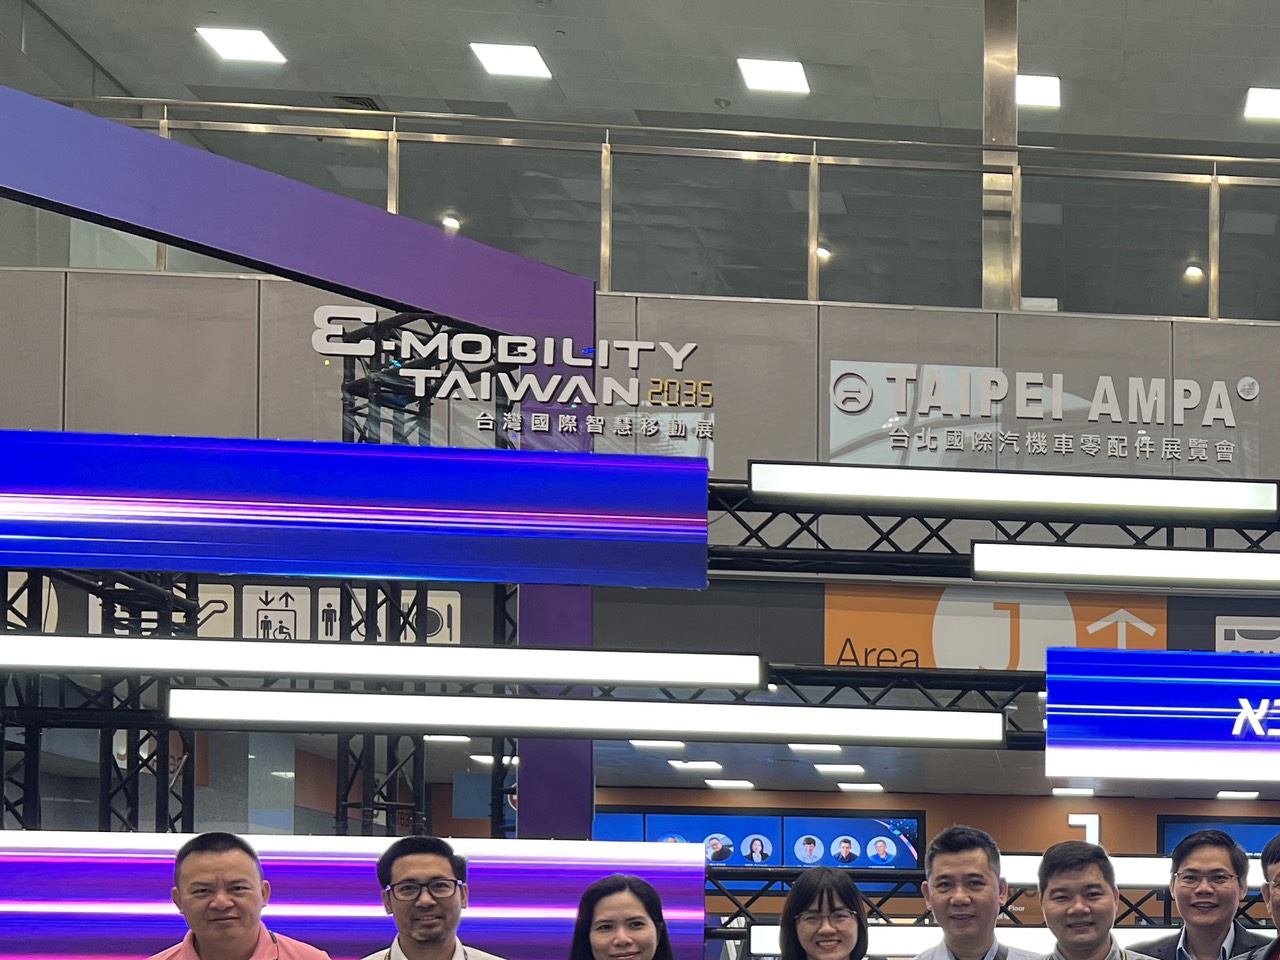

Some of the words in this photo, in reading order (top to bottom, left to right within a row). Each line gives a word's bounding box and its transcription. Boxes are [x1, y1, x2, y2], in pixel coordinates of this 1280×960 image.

[398, 368, 640, 406] TAIWAN
[647, 377, 714, 407] 2035
[886, 367, 1064, 420] TAIPEI
[1087, 375, 1237, 428] AMPA
[475, 411, 714, 440] 台灣國際智慧移動展
[887, 428, 1238, 463] 台北國際汽機車零配件展覽會
[836, 637, 920, 668] Area
